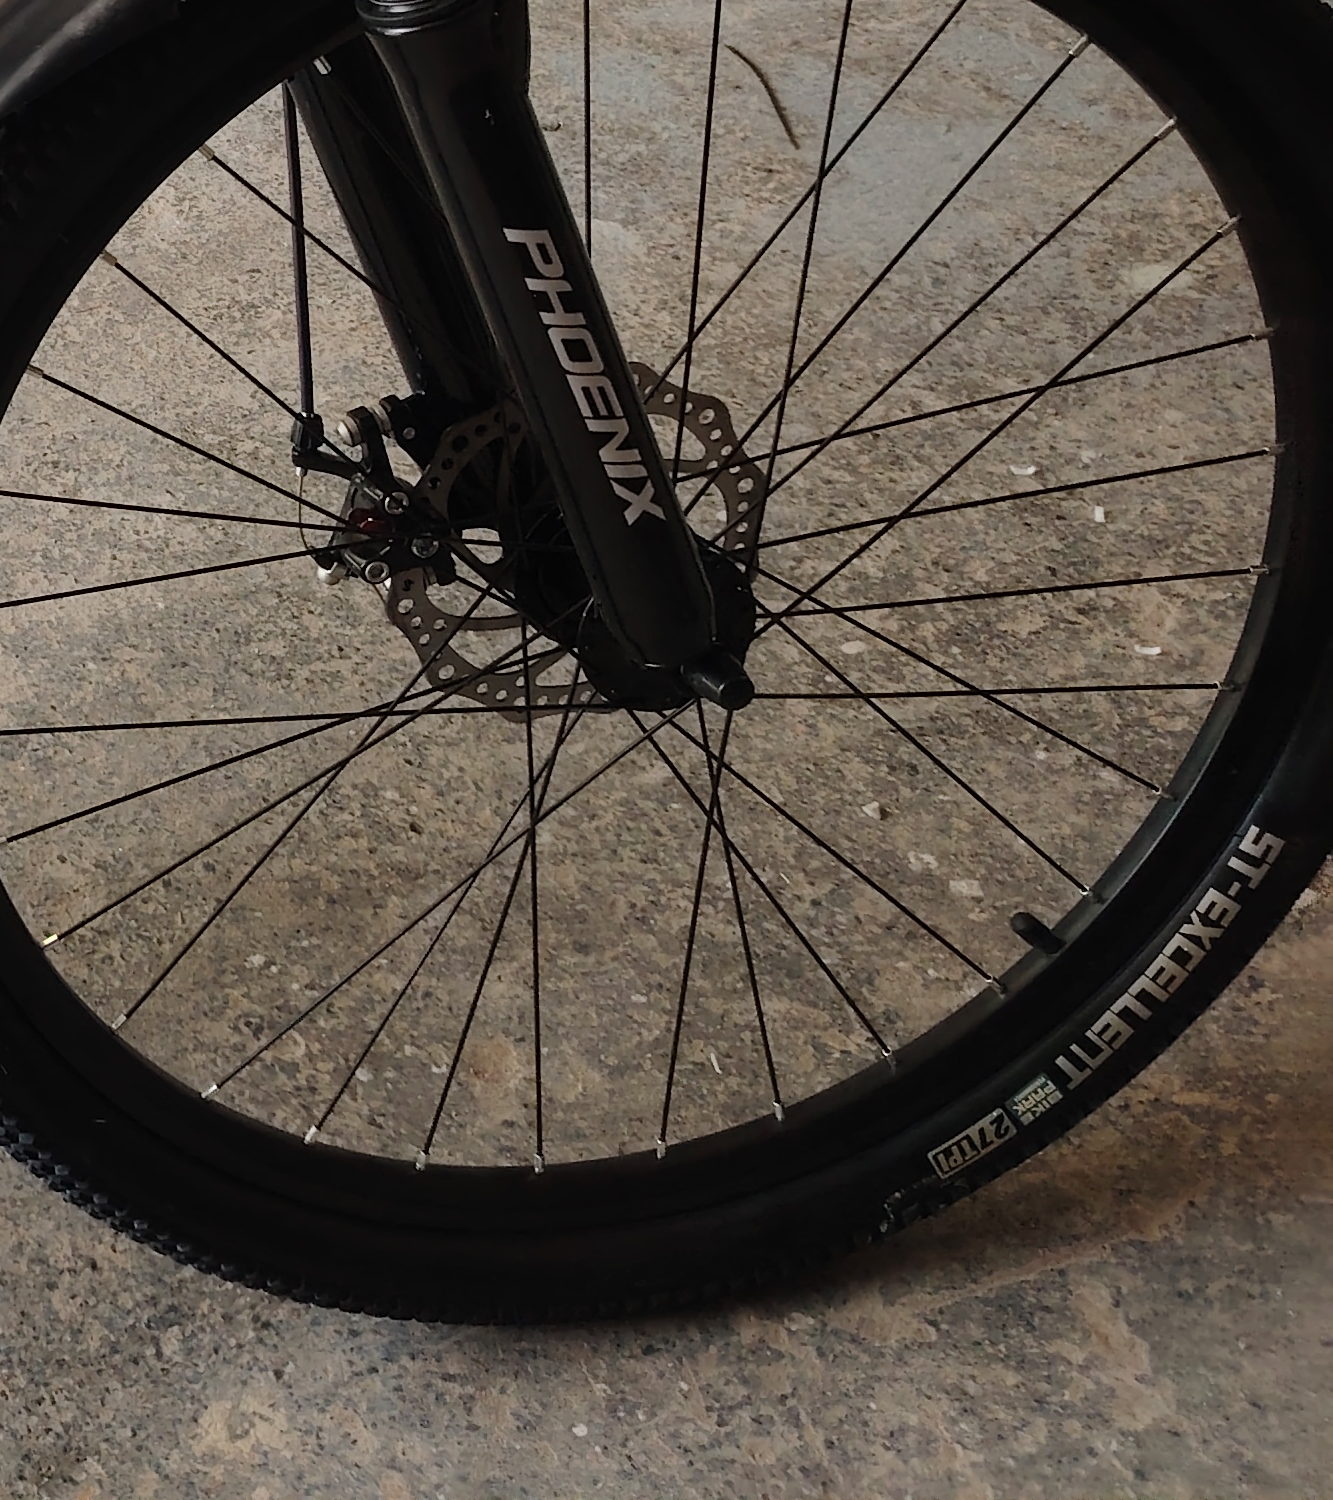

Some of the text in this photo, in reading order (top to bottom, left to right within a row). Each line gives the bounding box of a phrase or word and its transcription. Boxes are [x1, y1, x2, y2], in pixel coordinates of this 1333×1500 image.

[503, 227, 667, 527] PHOENIX
[1053, 823, 1287, 1090] ST-EXCELLENT
[1012, 1080, 1057, 1116] PARK
